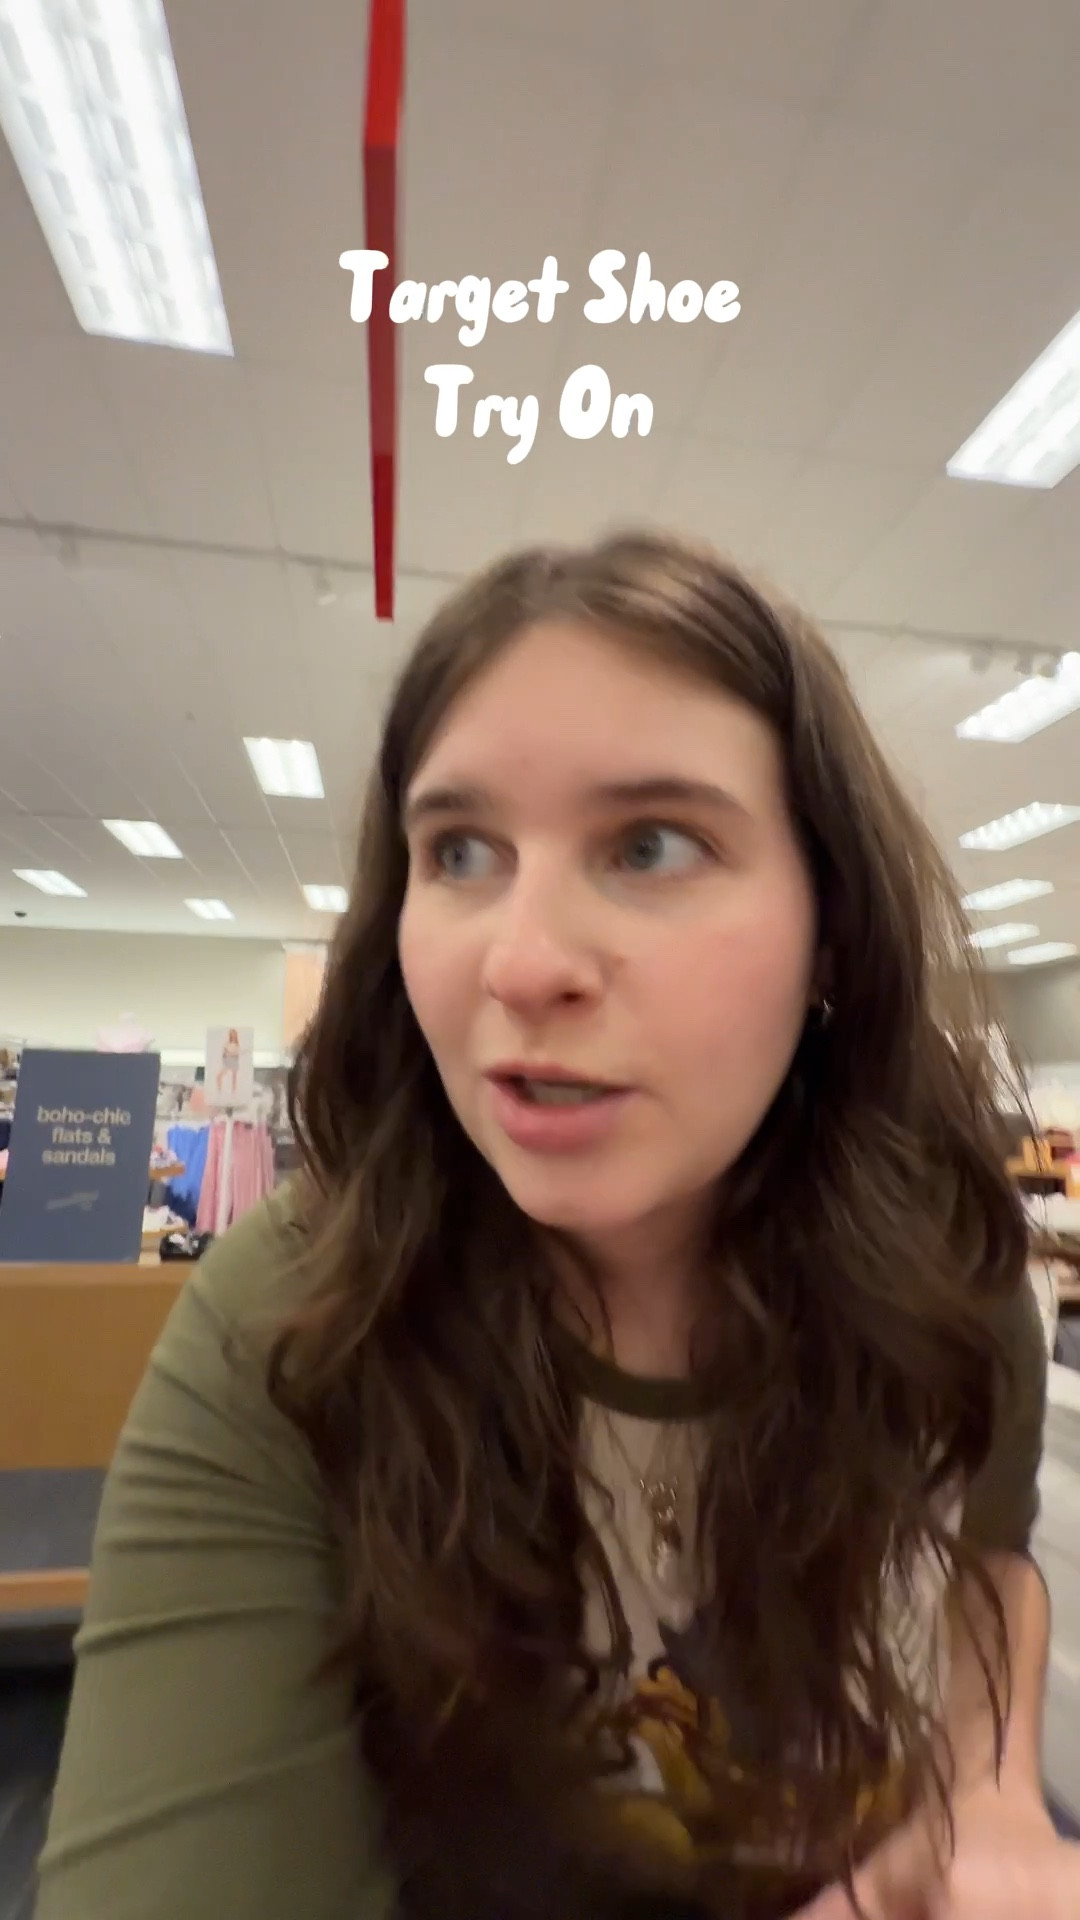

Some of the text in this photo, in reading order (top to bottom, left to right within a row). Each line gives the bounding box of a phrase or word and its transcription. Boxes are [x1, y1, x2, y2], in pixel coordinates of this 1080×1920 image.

[37, 1105, 131, 1125] boho-chic
[52, 1126, 112, 1145] flats &
[42, 1147, 116, 1165] sandals
